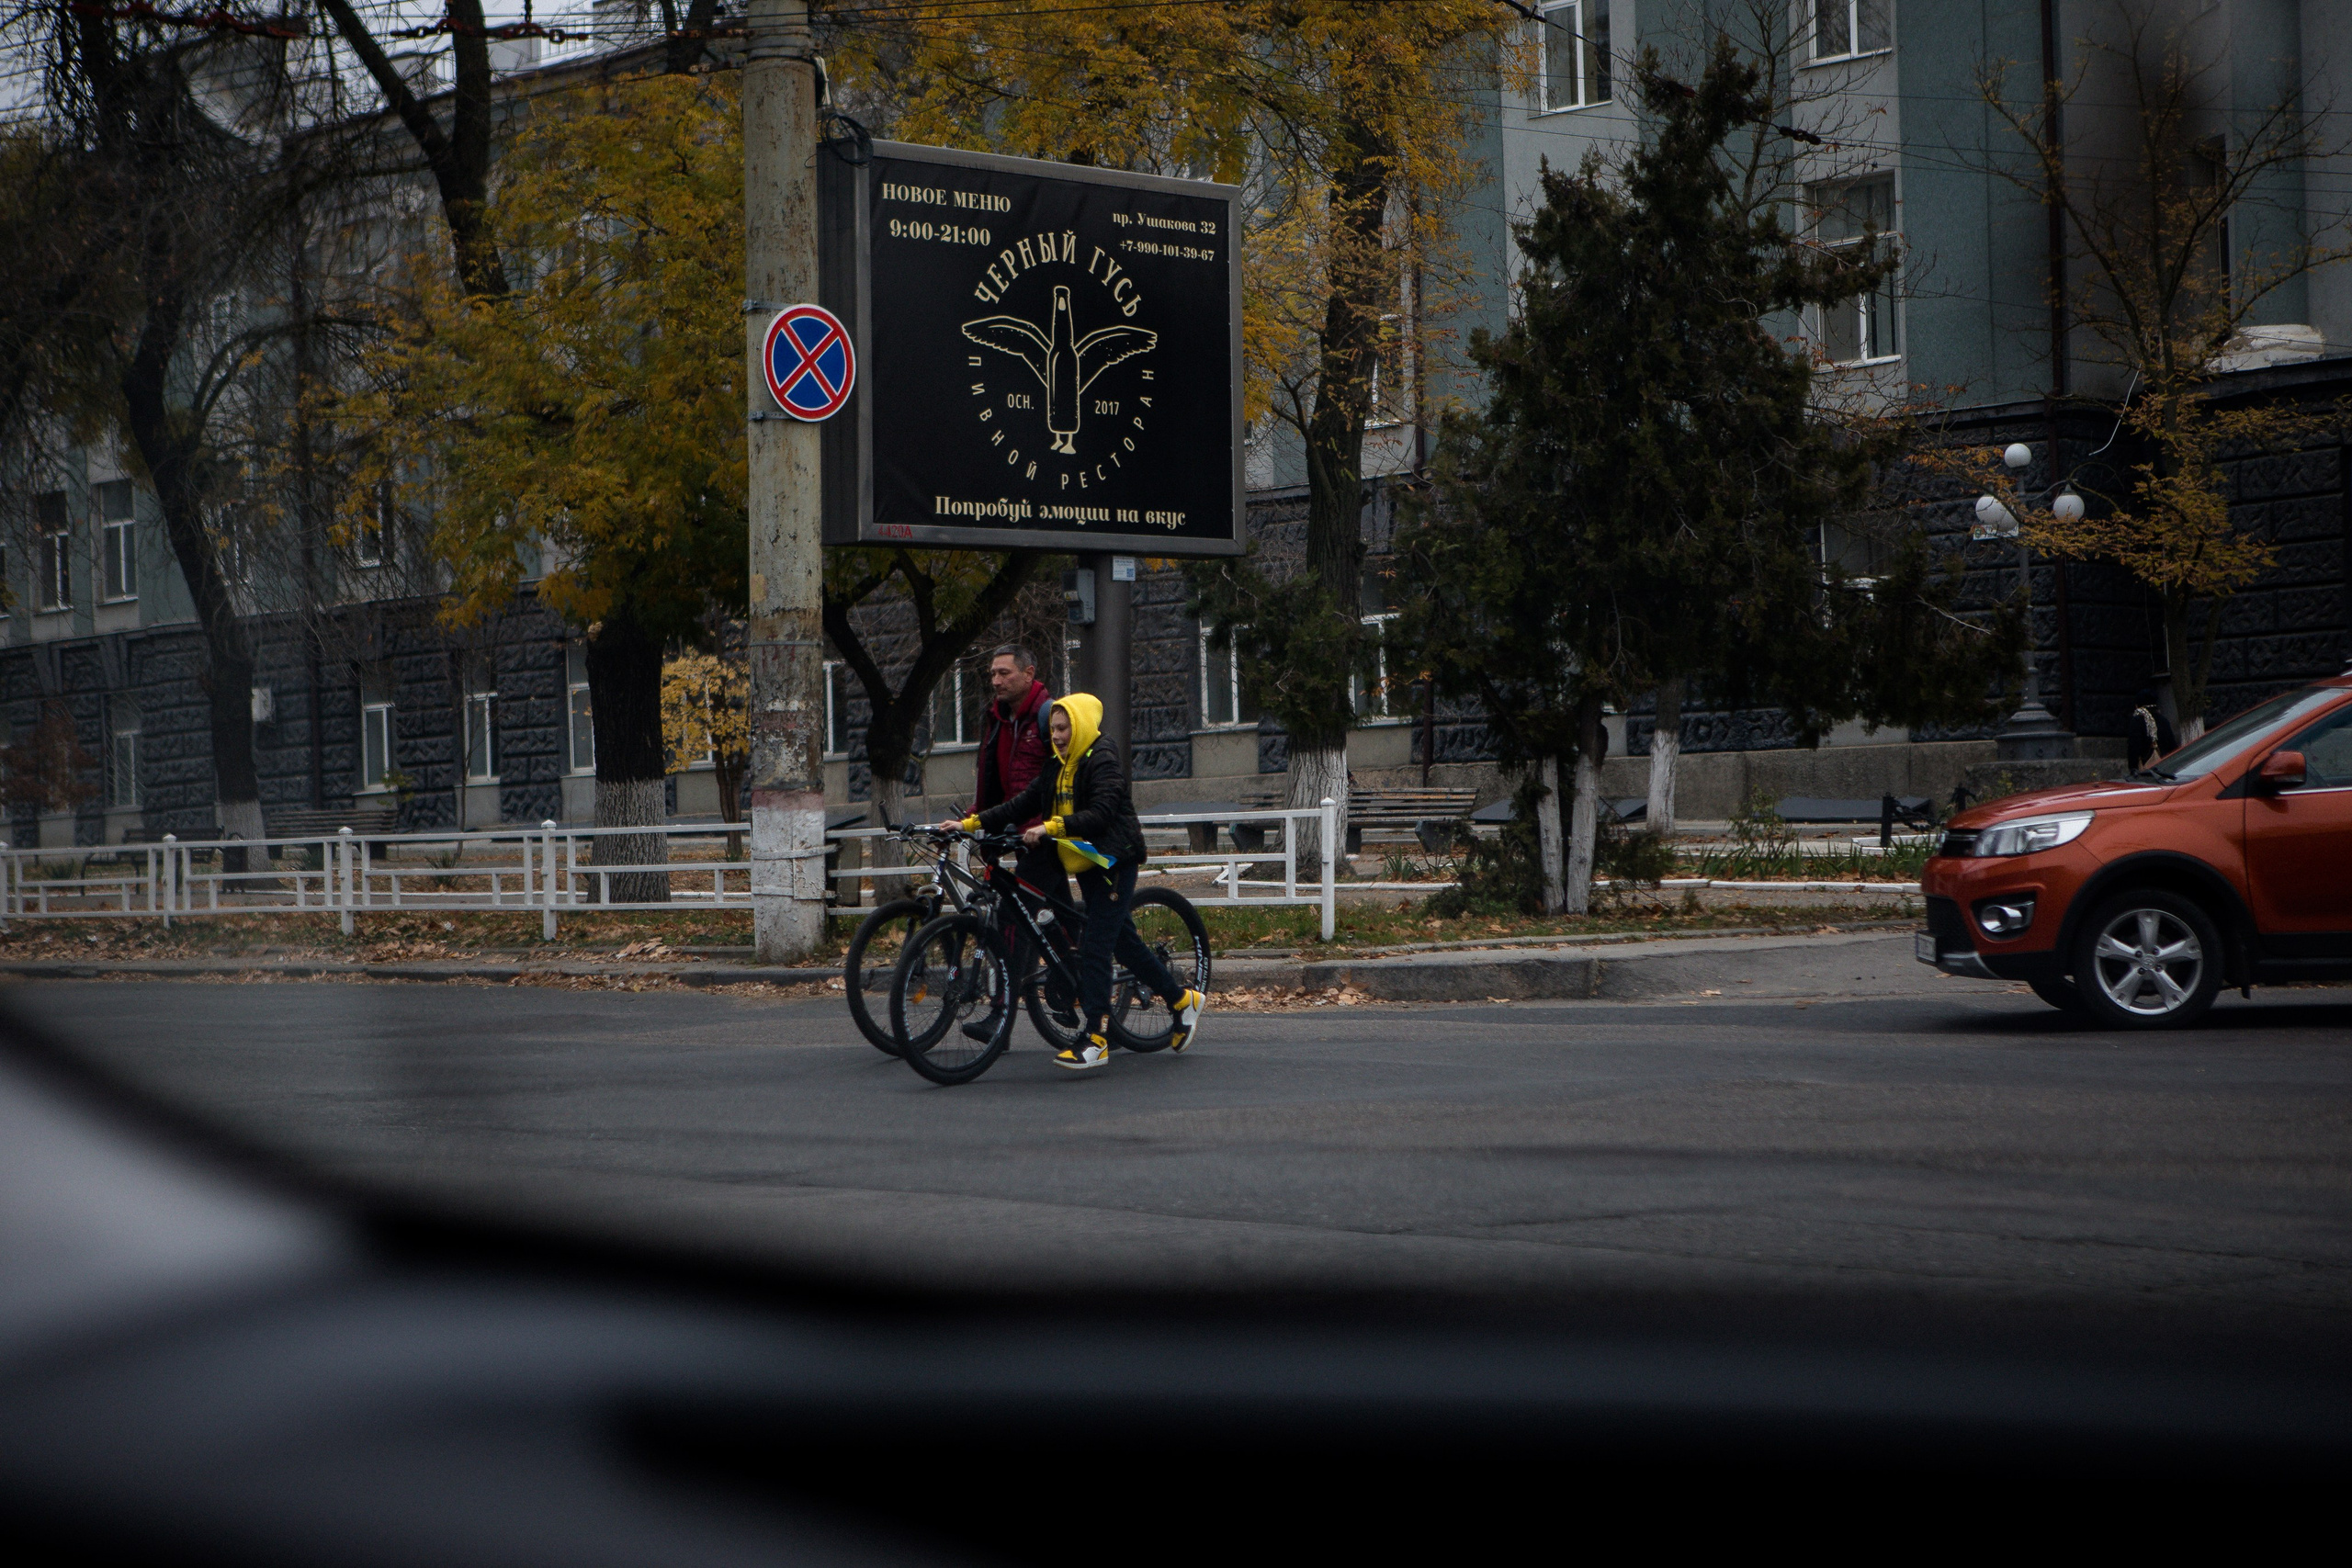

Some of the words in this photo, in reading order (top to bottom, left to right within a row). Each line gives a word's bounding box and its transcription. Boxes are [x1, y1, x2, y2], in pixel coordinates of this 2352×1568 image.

[882, 183, 947, 206] НОВОЕ
[954, 191, 1012, 213] МЕНЮ
[889, 219, 991, 246] 9:00-21:00
[1113, 212, 1133, 227] пр.
[1137, 212, 1197, 232] Ушакова
[1200, 220, 1216, 235] 32
[1119, 240, 1216, 262] +7-990-101-39-67
[974, 230, 1077, 305] ЧЕРНЫЙ
[1088, 245, 1142, 317] ГУСЬ
[1007, 393, 1035, 410] ОСН.
[1094, 400, 1120, 415] 2017
[968, 355, 1038, 480] ПИВНОЙ
[1061, 369, 1155, 491] РЕСТОРАН
[934, 495, 1033, 523] Попробуй
[1039, 505, 1111, 525] эмоции
[1116, 506, 1139, 524] на
[1146, 509, 1187, 530] вкус
[1012, 891, 1061, 963] KINETIC
